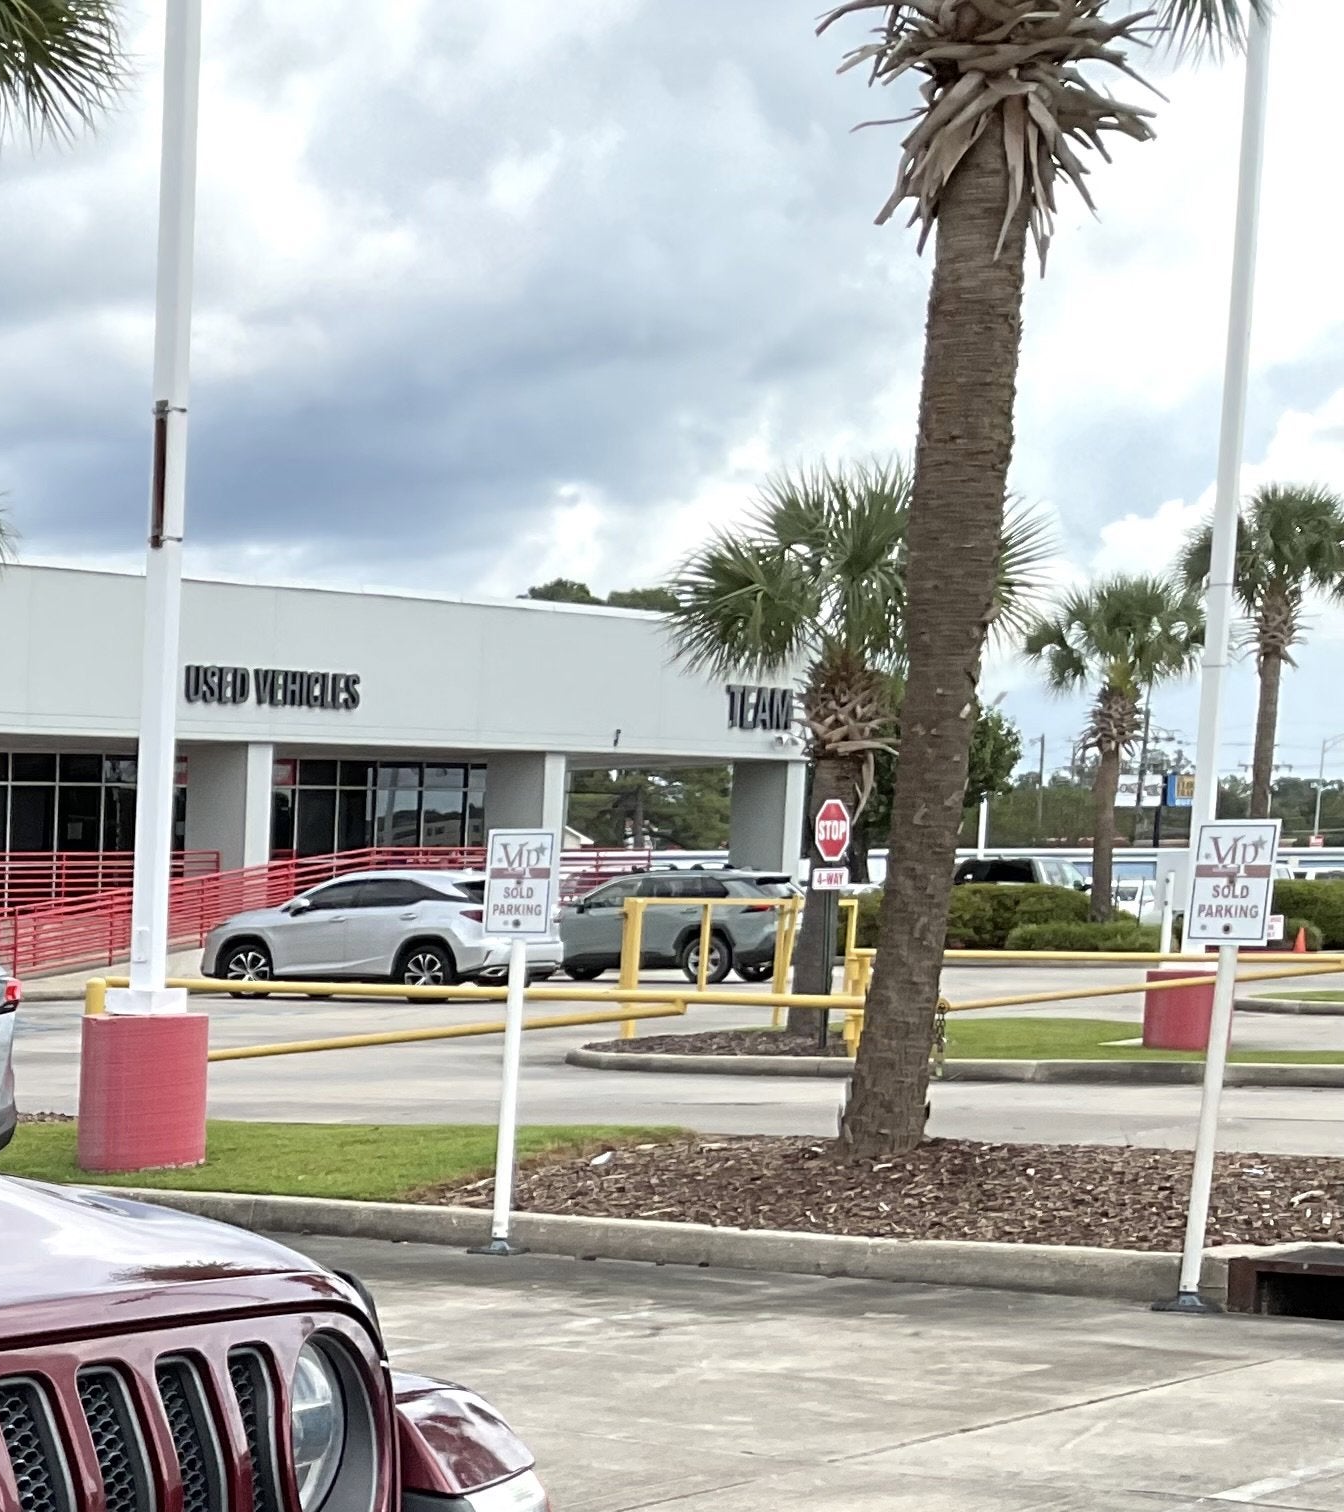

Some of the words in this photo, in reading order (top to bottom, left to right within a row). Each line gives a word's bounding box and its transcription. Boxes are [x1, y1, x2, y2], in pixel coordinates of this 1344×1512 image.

[184, 664, 250, 704] USED
[253, 667, 361, 710] VEHICLES
[726, 684, 793, 730] TEAM
[818, 820, 846, 841] STOP
[816, 872, 844, 886] 4-WAY
[503, 886, 534, 899] SOLD
[1211, 884, 1250, 899] SOLD
[492, 904, 542, 917] PARKING
[1197, 904, 1259, 919] PARKING
